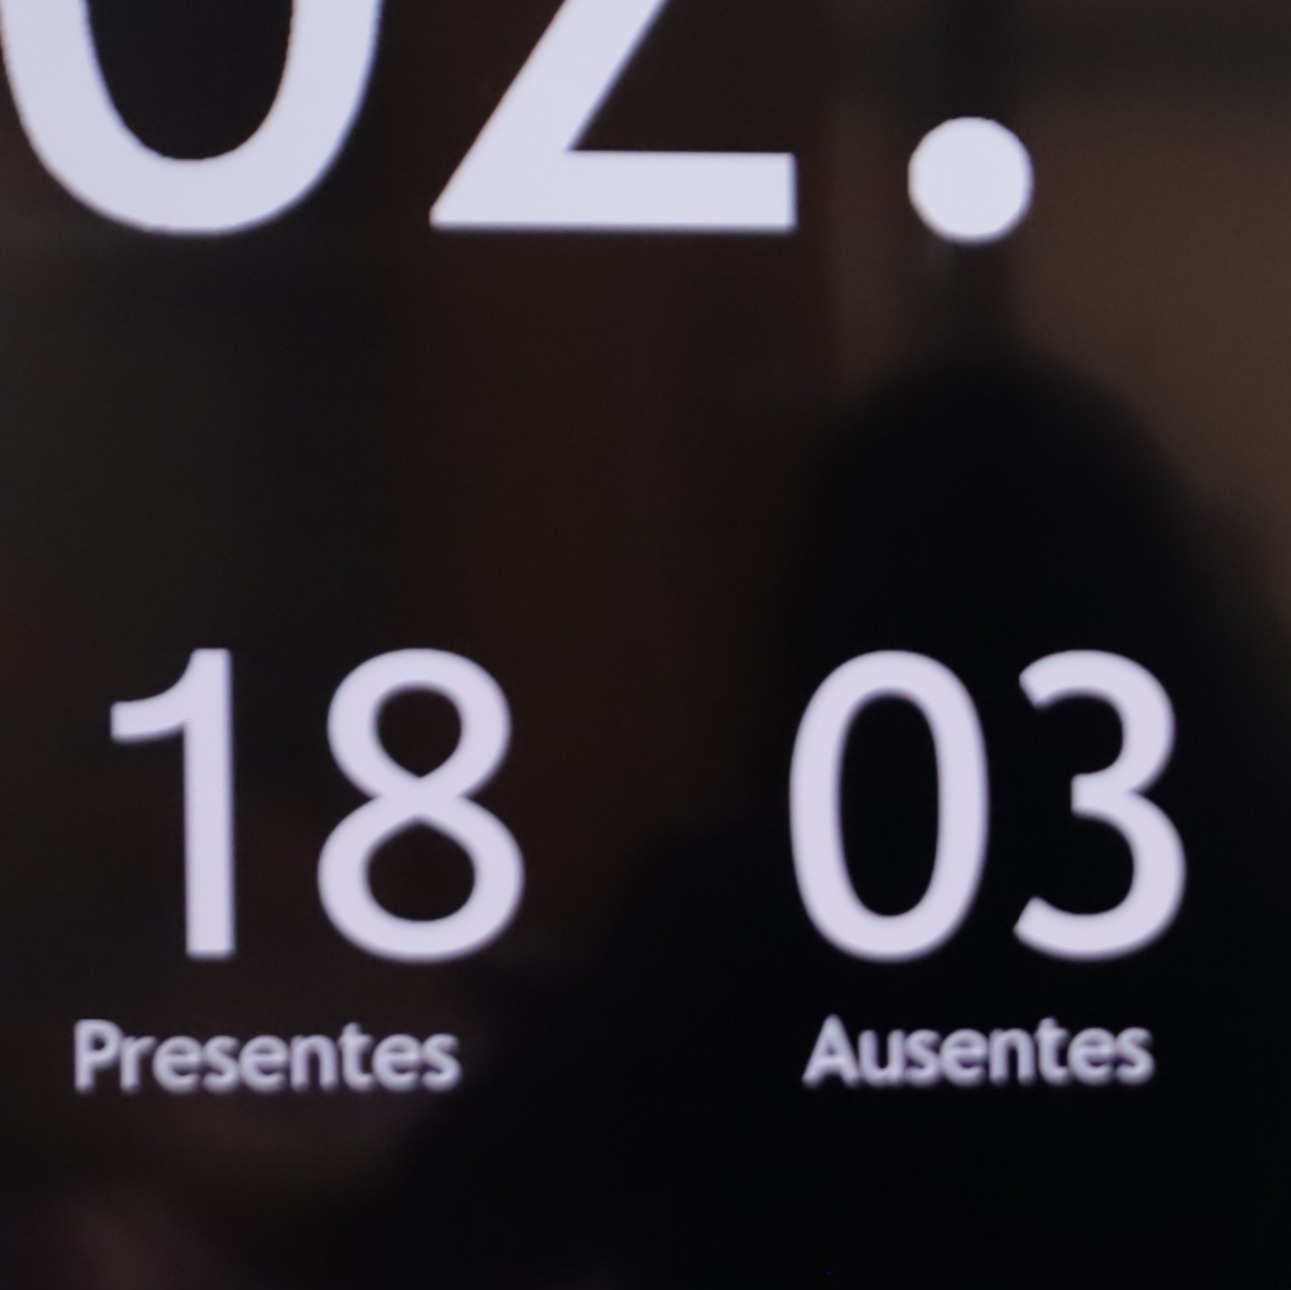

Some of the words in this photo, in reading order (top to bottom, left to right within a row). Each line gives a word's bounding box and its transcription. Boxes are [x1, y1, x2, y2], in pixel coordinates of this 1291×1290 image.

[110, 648, 523, 960] 18
[788, 650, 1186, 958] 03
[74, 1018, 461, 1090] Presentes
[803, 1016, 1154, 1083] Ausentes
